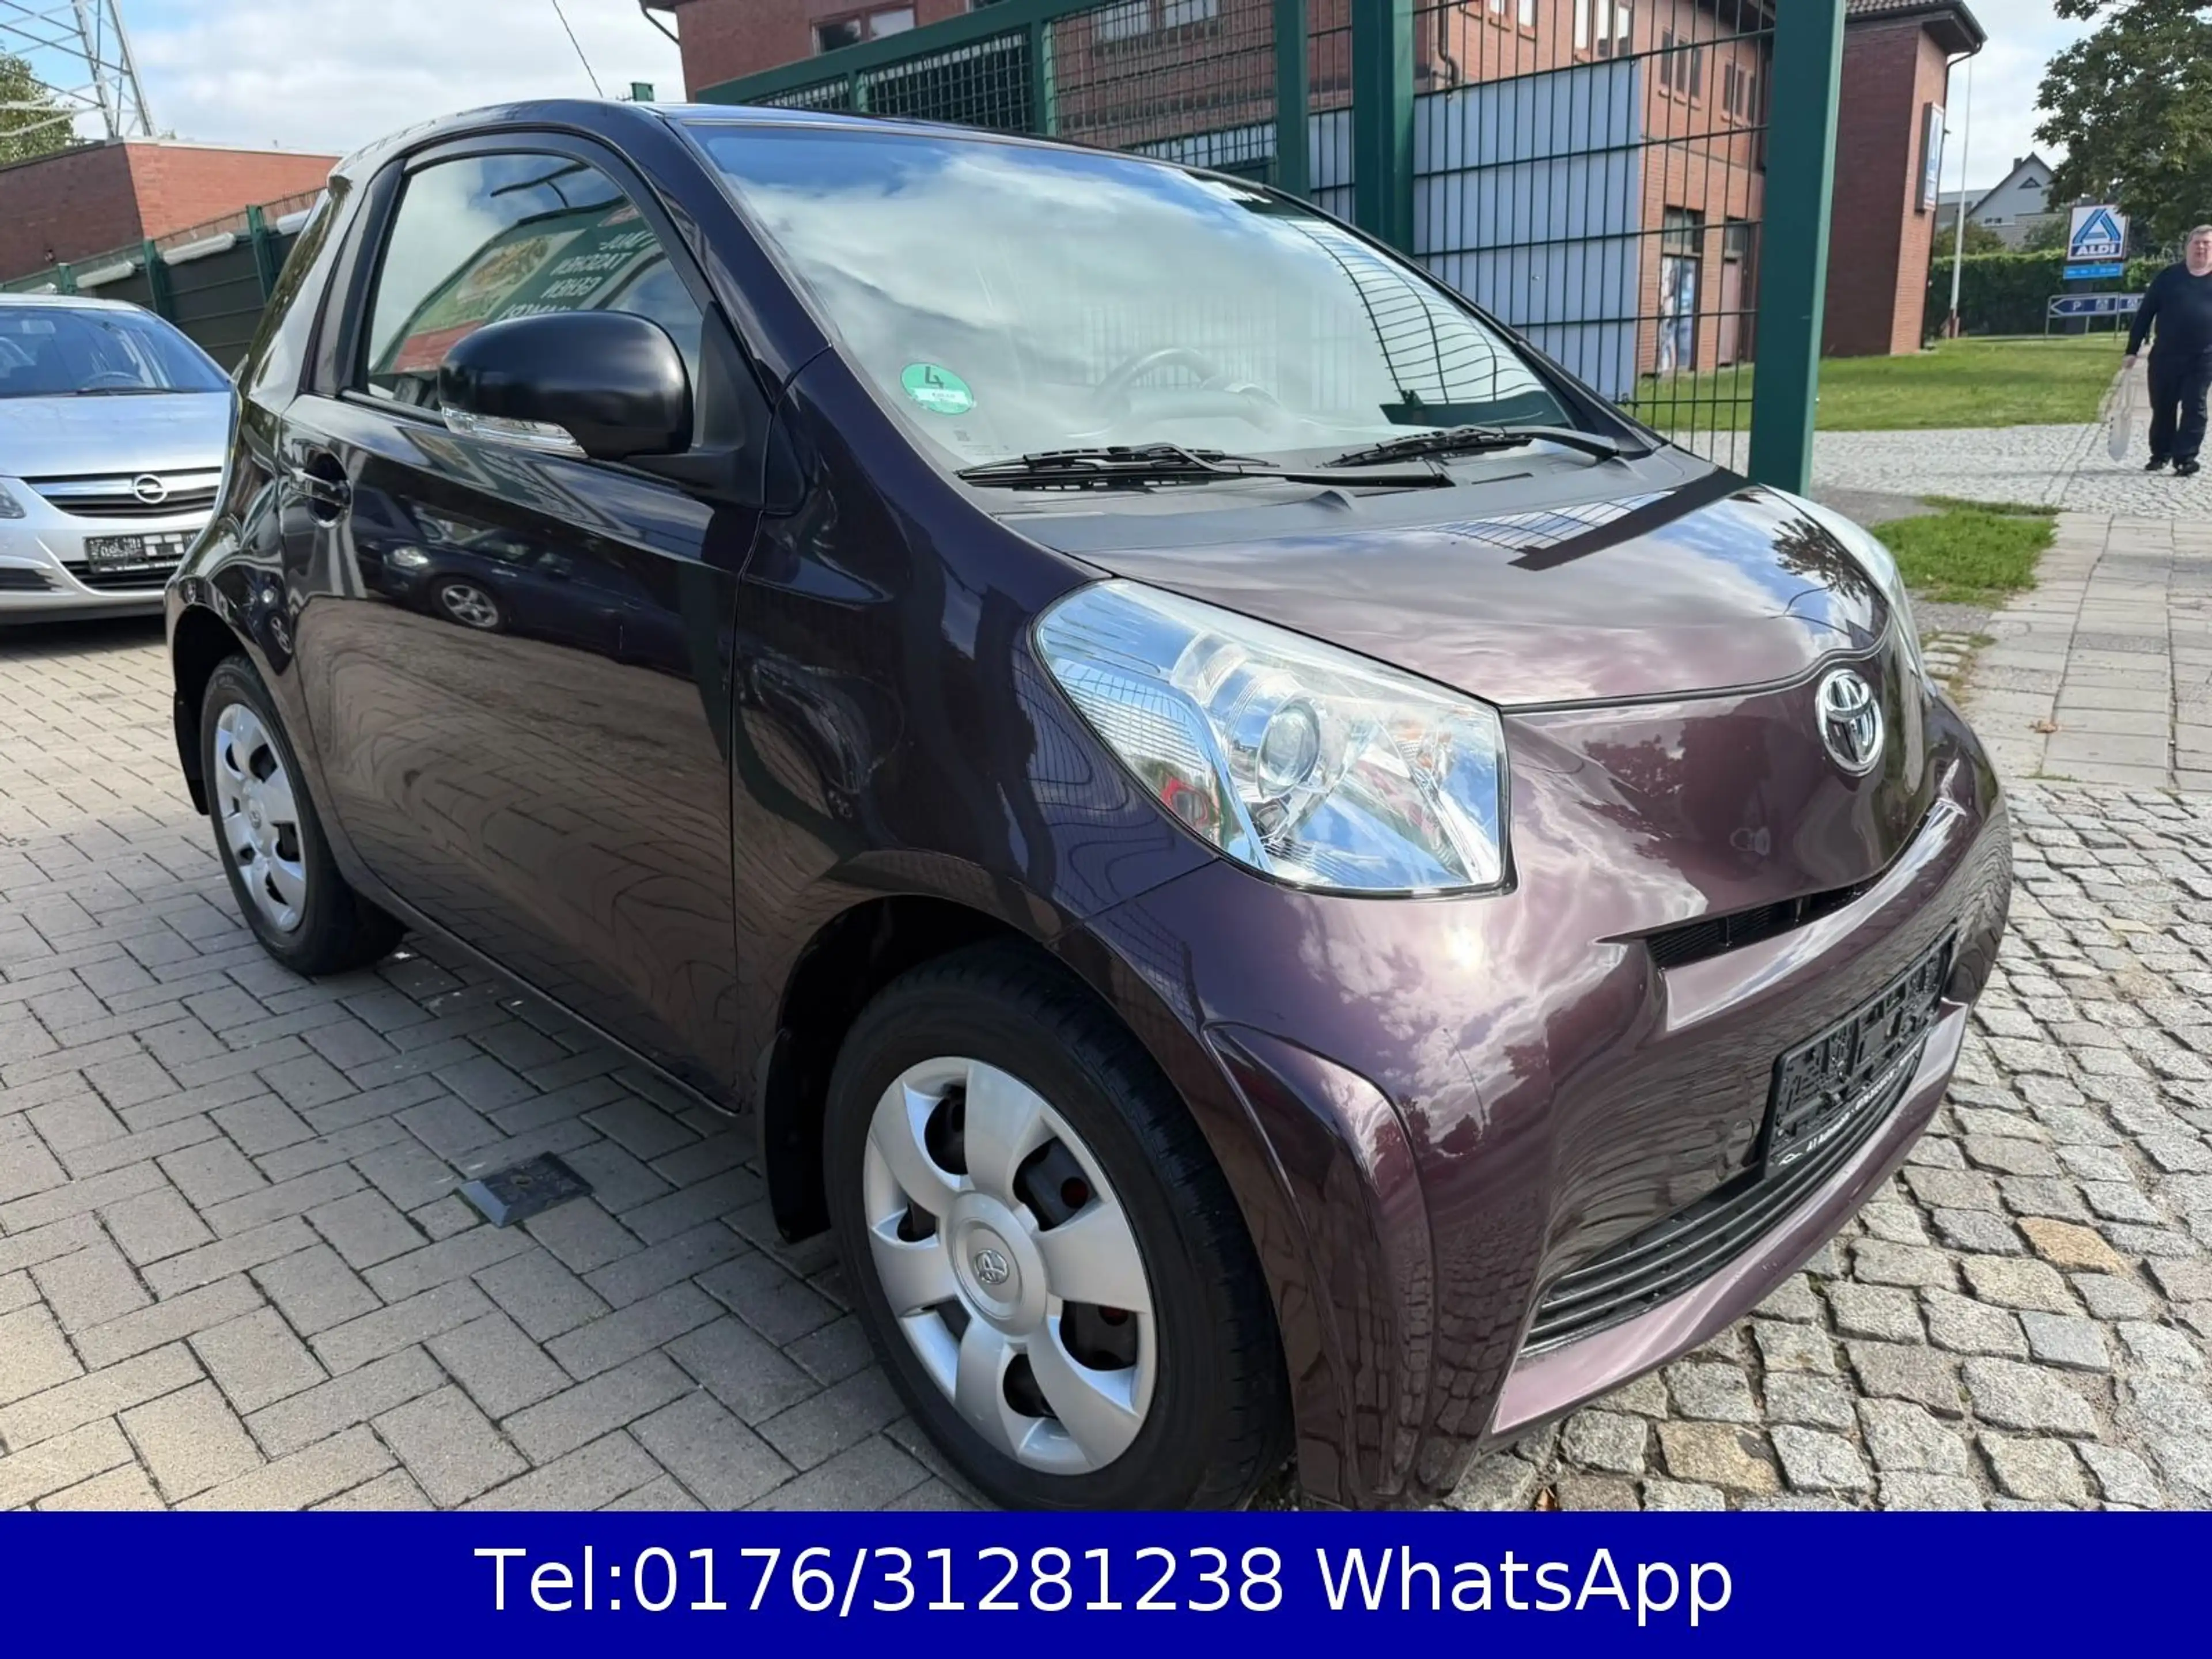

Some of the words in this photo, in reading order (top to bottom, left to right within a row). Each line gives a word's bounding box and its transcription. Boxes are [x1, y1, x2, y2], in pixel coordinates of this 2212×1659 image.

[2076, 245, 2116, 255] ALDI
[2073, 301, 2082, 311] P
[925, 366, 944, 389] 4
